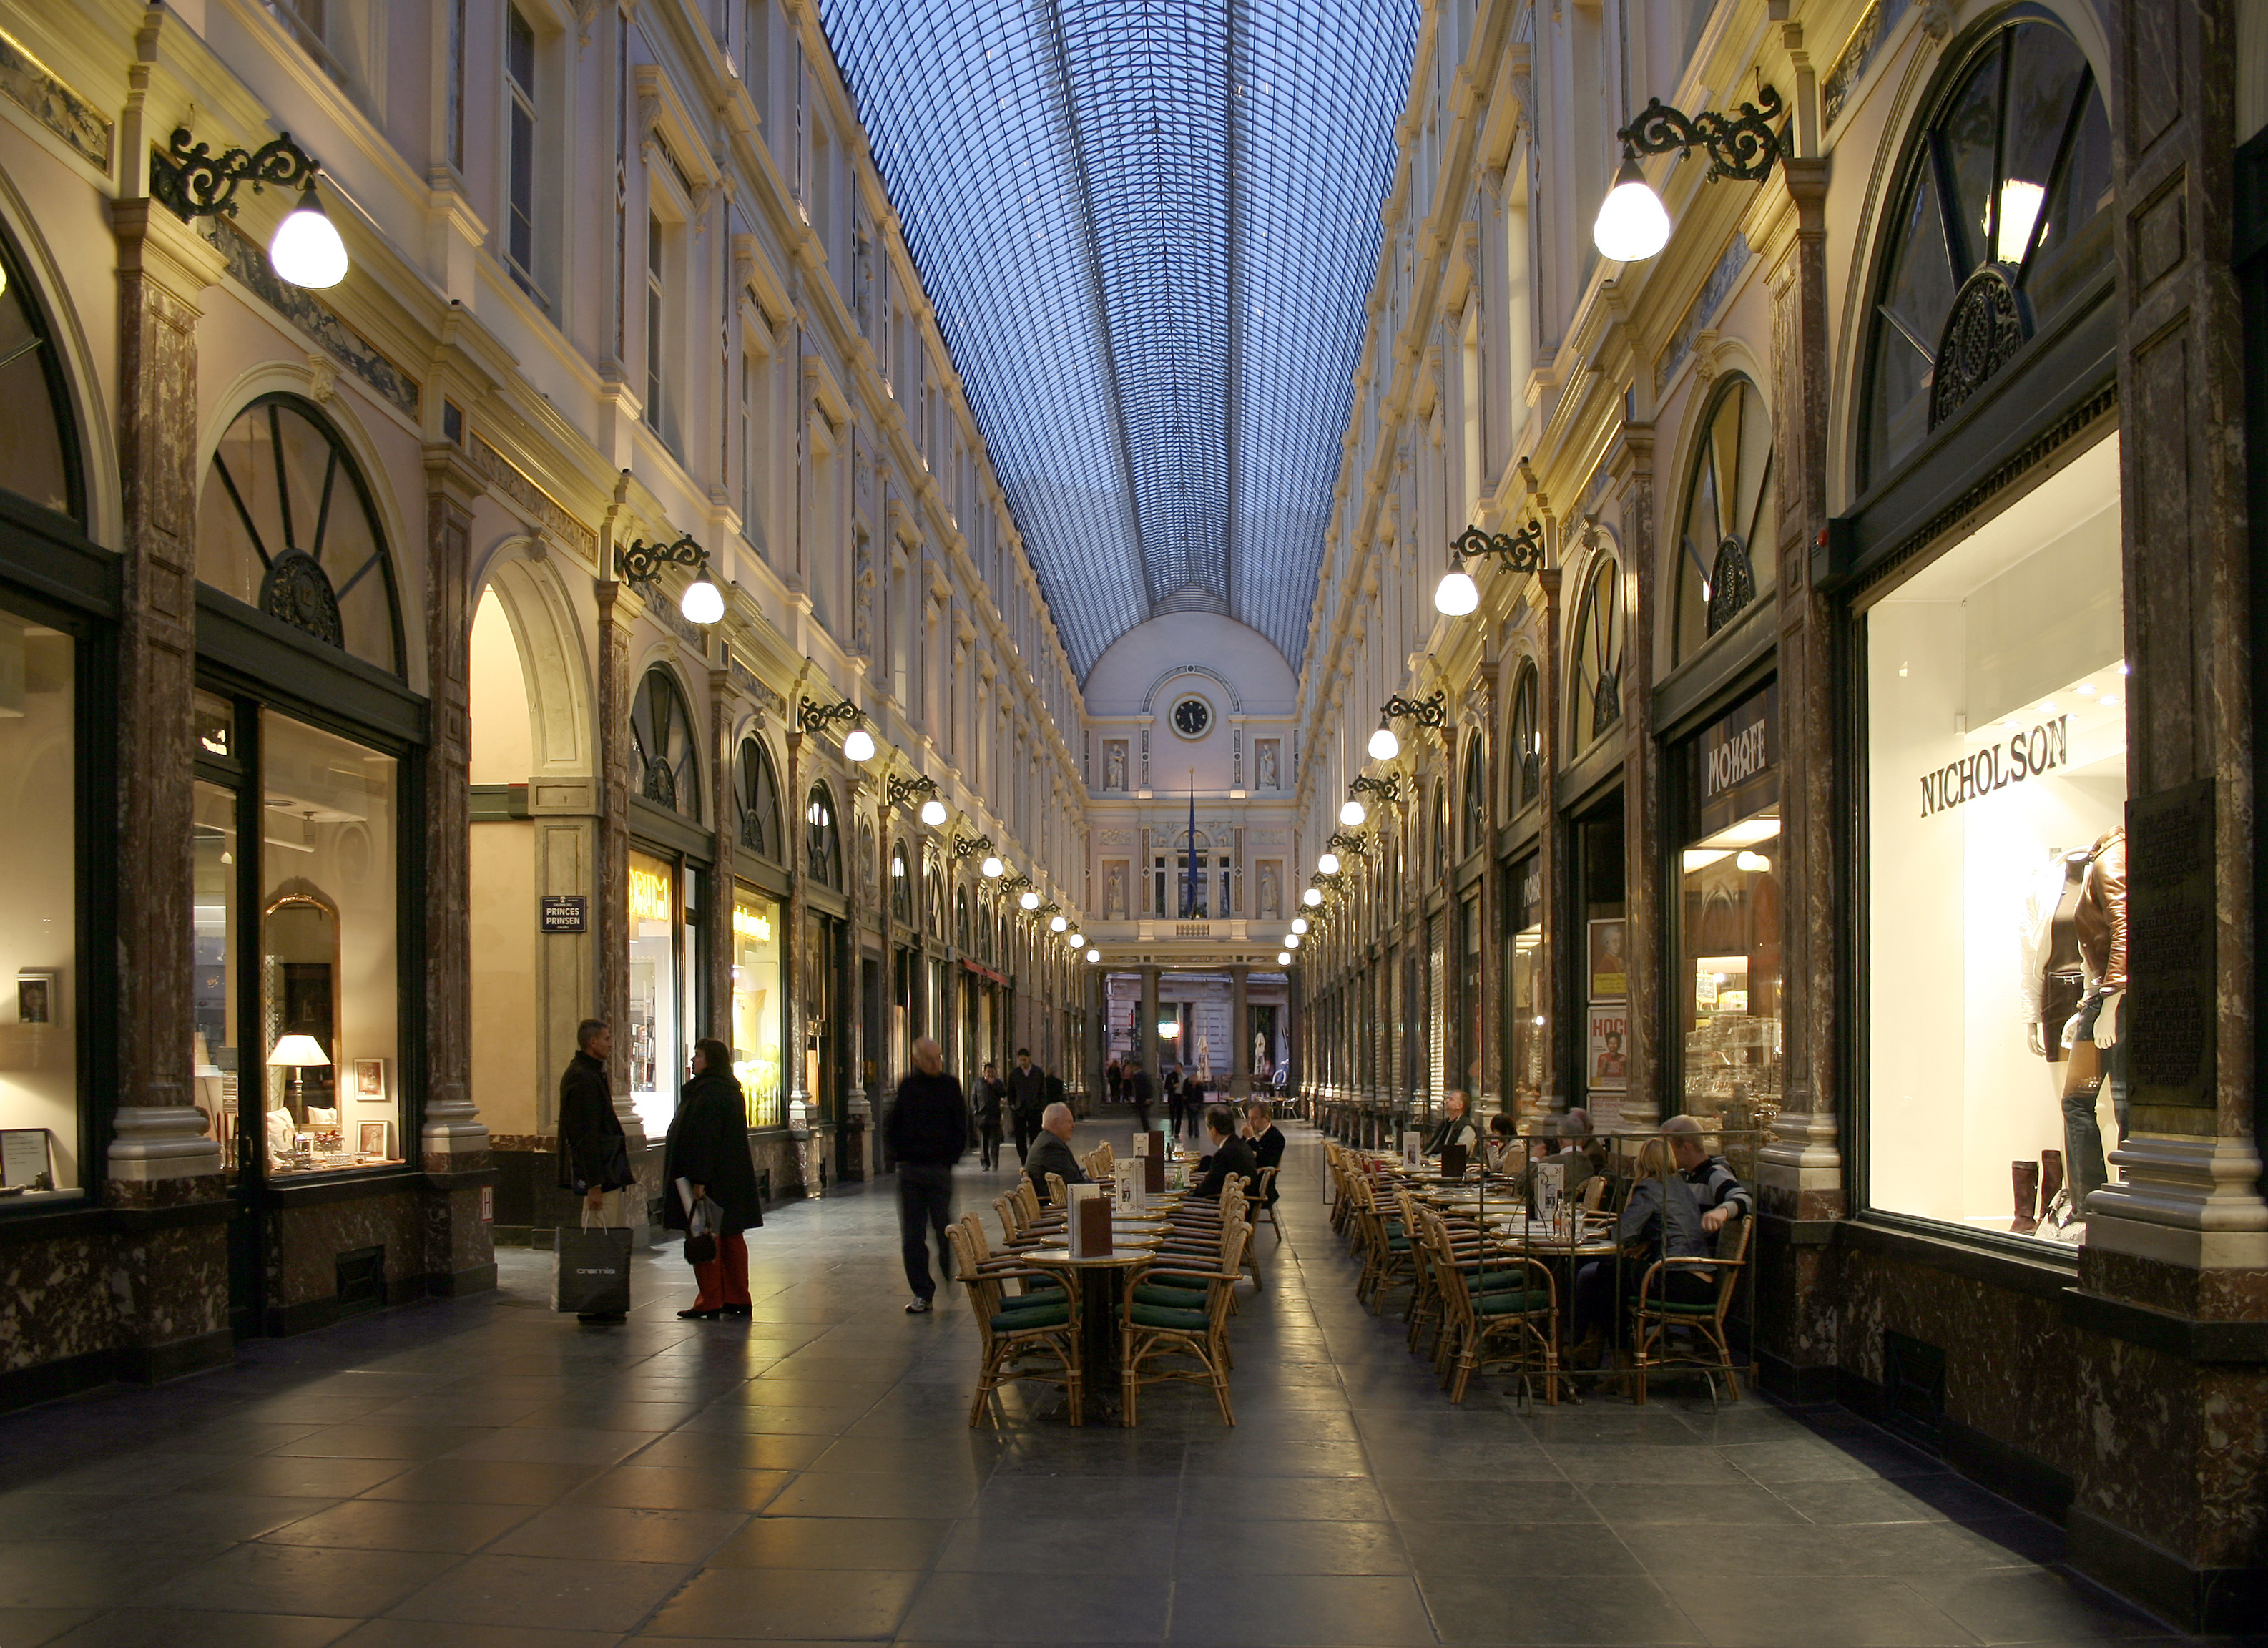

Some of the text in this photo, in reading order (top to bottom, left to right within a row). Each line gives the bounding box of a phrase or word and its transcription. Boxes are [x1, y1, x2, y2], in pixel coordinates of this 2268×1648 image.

[1707, 718, 1766, 797] MOKAFE
[1920, 713, 2068, 818] NICHOLSON
[1592, 1018, 1627, 1037] HOC
[483, 1191, 491, 1215] H
